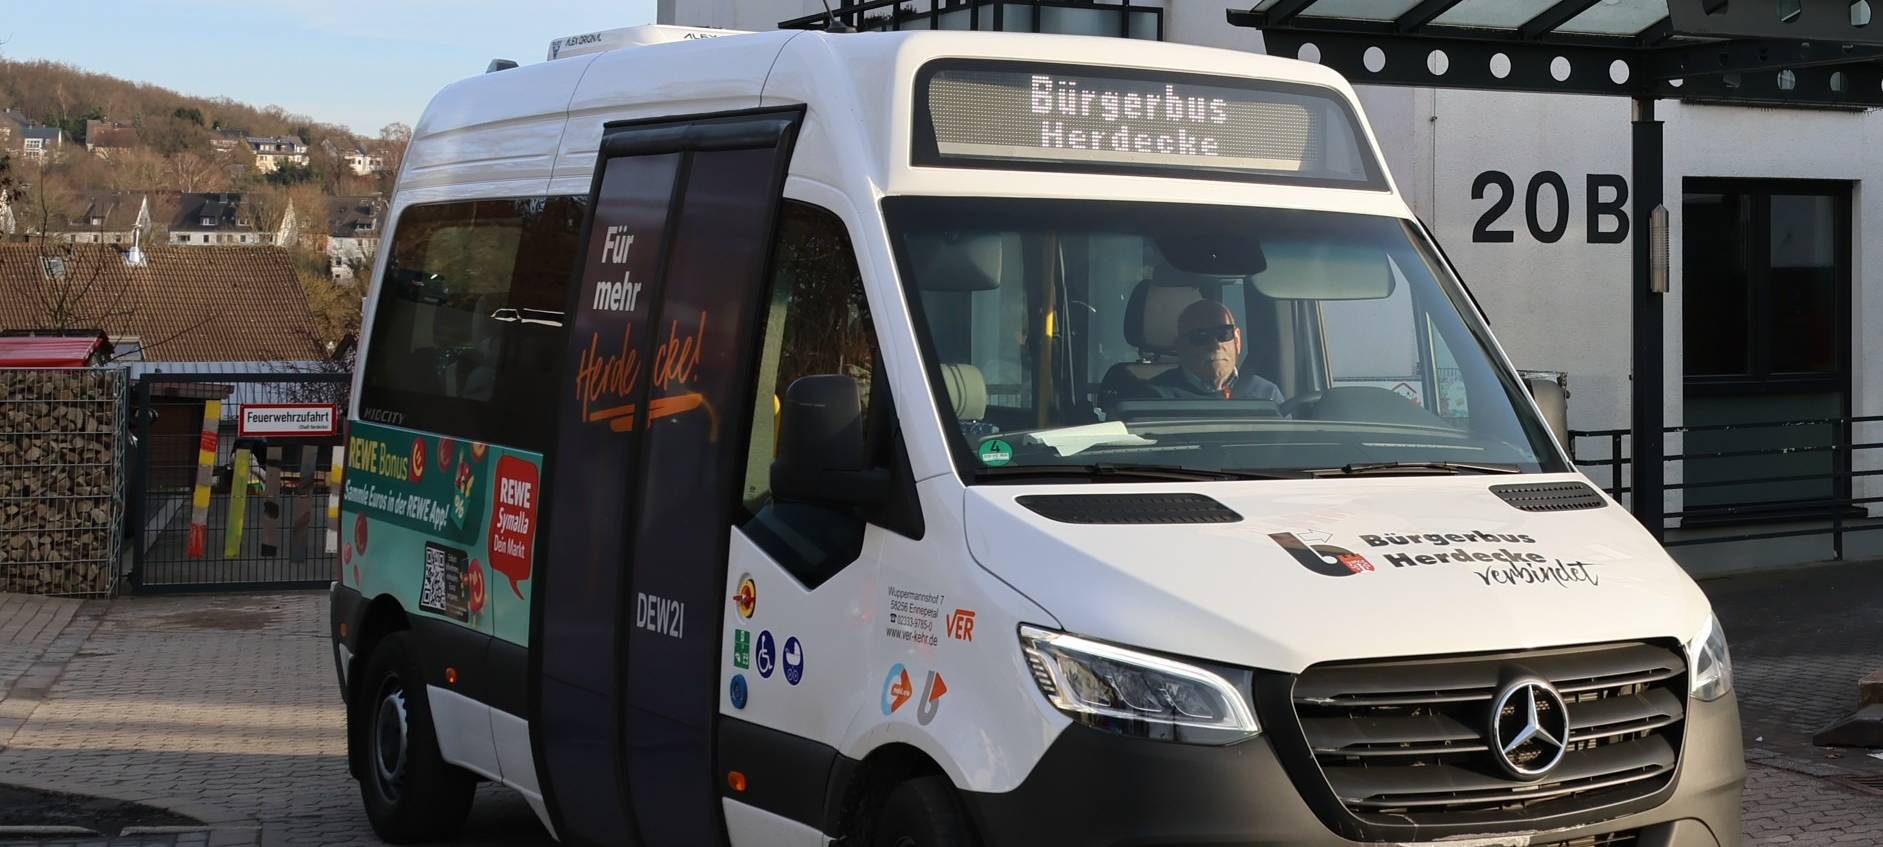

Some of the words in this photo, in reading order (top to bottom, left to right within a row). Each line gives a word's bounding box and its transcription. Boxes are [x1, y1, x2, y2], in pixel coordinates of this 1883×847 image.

[1031, 75, 1227, 123] Bürgerbus
[1041, 121, 1218, 156] Herdecke
[601, 225, 634, 264] Für
[592, 271, 642, 312] mehr
[247, 411, 329, 423] Feuerwehrzufahrt
[348, 436, 378, 473] REWE
[379, 442, 409, 481] Bonus
[990, 440, 1001, 453] 4
[344, 479, 369, 506] Sammle
[368, 485, 388, 511] Euros
[387, 489, 396, 512] in
[394, 492, 407, 516] der
[406, 494, 432, 522] REWE
[428, 500, 450, 532] App!
[500, 477, 532, 509] REWE
[497, 507, 529, 534] Symalla
[494, 534, 507, 553] Dein
[506, 537, 525, 559] Markt
[1359, 530, 1536, 547] Bürgerbus
[1383, 549, 1547, 567] Herdecke
[1473, 558, 1602, 588] verbindet
[909, 602, 938, 619] Ennepetal
[939, 595, 945, 606] 7
[946, 609, 976, 642] VER
